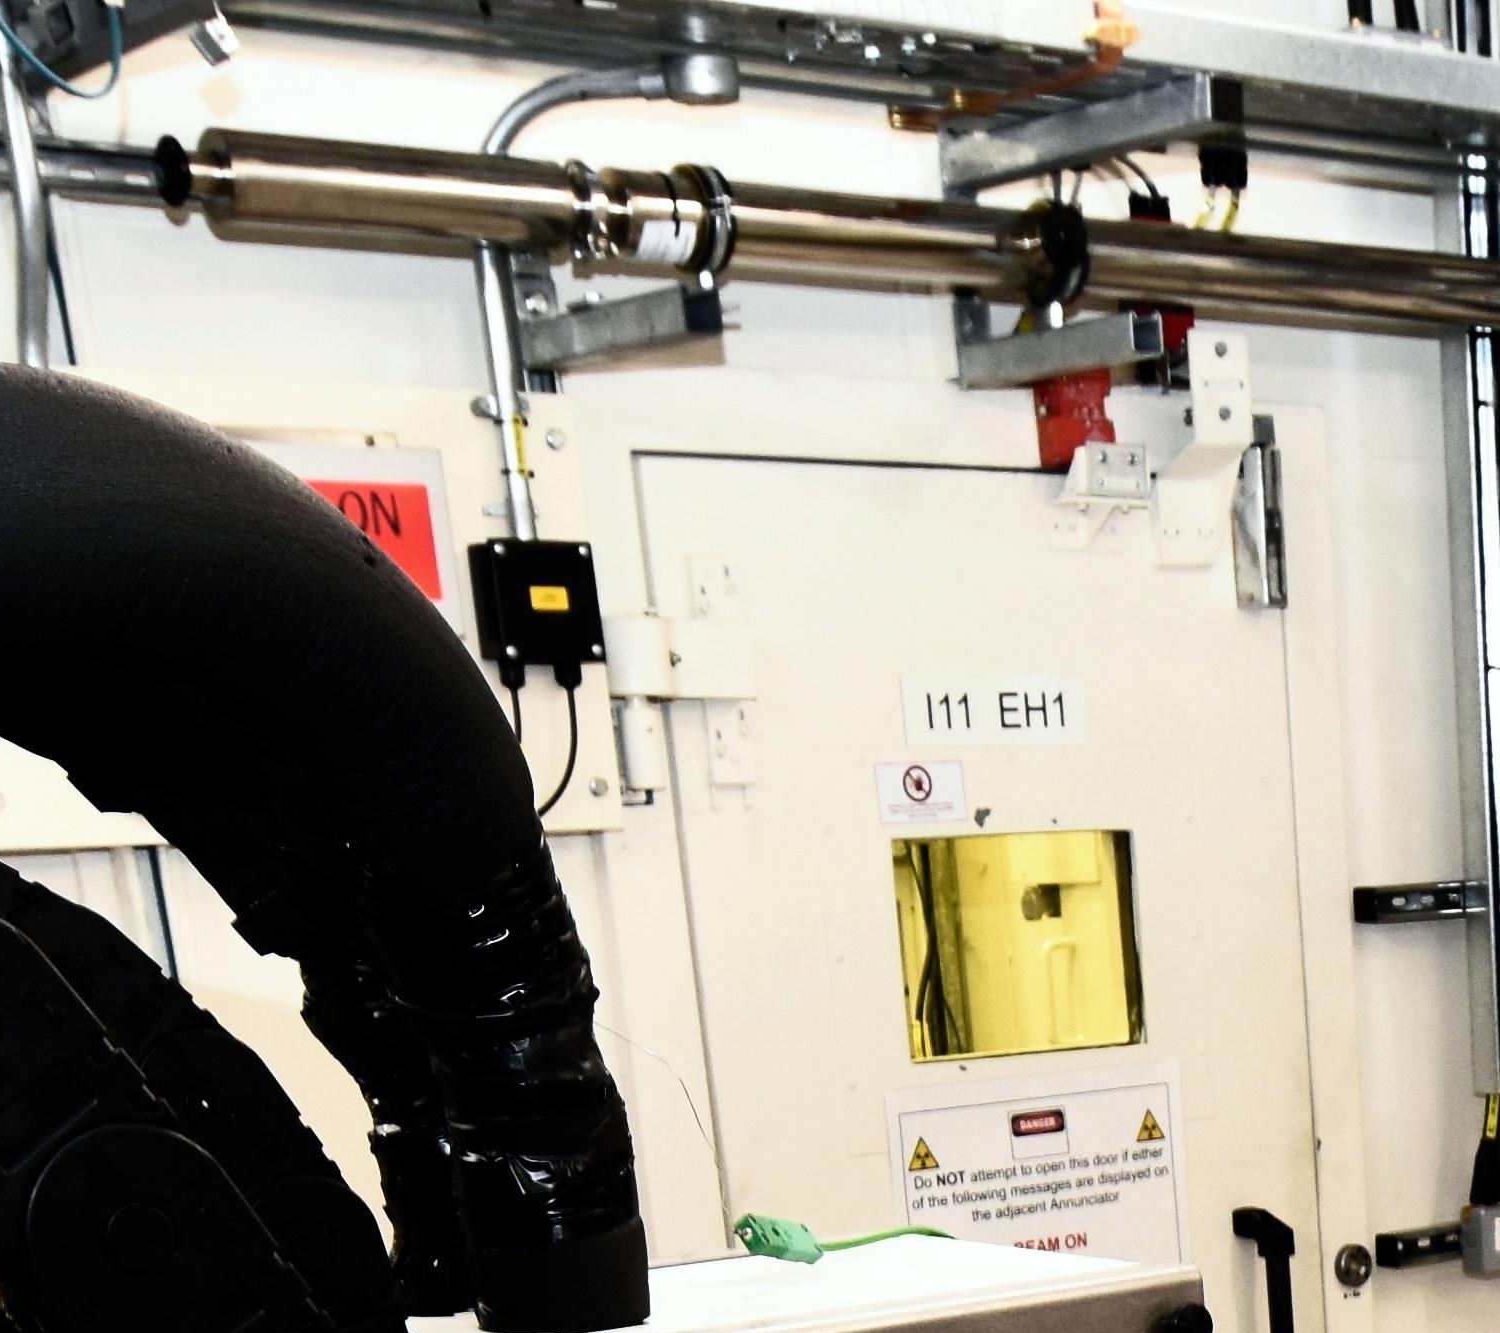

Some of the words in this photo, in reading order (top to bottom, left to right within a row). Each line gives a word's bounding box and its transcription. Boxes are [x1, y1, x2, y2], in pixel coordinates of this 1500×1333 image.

[339, 490, 402, 538] ON
[926, 692, 971, 729] I11
[999, 691, 1065, 728] EH1
[1019, 1116, 1056, 1131] DANGER
[912, 1195, 924, 1210] of
[928, 1194, 948, 1208] the
[952, 1187, 1007, 1201] following
[1011, 1180, 1072, 1194] messages
[1075, 1177, 1094, 1188] are
[1097, 1167, 1151, 1185] displayed
[1154, 1164, 1169, 1177] on
[914, 1175, 932, 1189] Do
[936, 1170, 966, 1187] NOT
[970, 1166, 1017, 1182] attempt
[1020, 1164, 1032, 1175] to
[1035, 1160, 1066, 1175] open
[1069, 1157, 1090, 1169] this
[1093, 1152, 1118, 1166] door
[1122, 1150, 1129, 1161] if
[1132, 1147, 1163, 1161] either
[972, 1209, 991, 1222] the
[995, 1201, 1047, 1220] adjacent
[1050, 1190, 1120, 1211] Annunciator
[1064, 1231, 1088, 1249] ON
